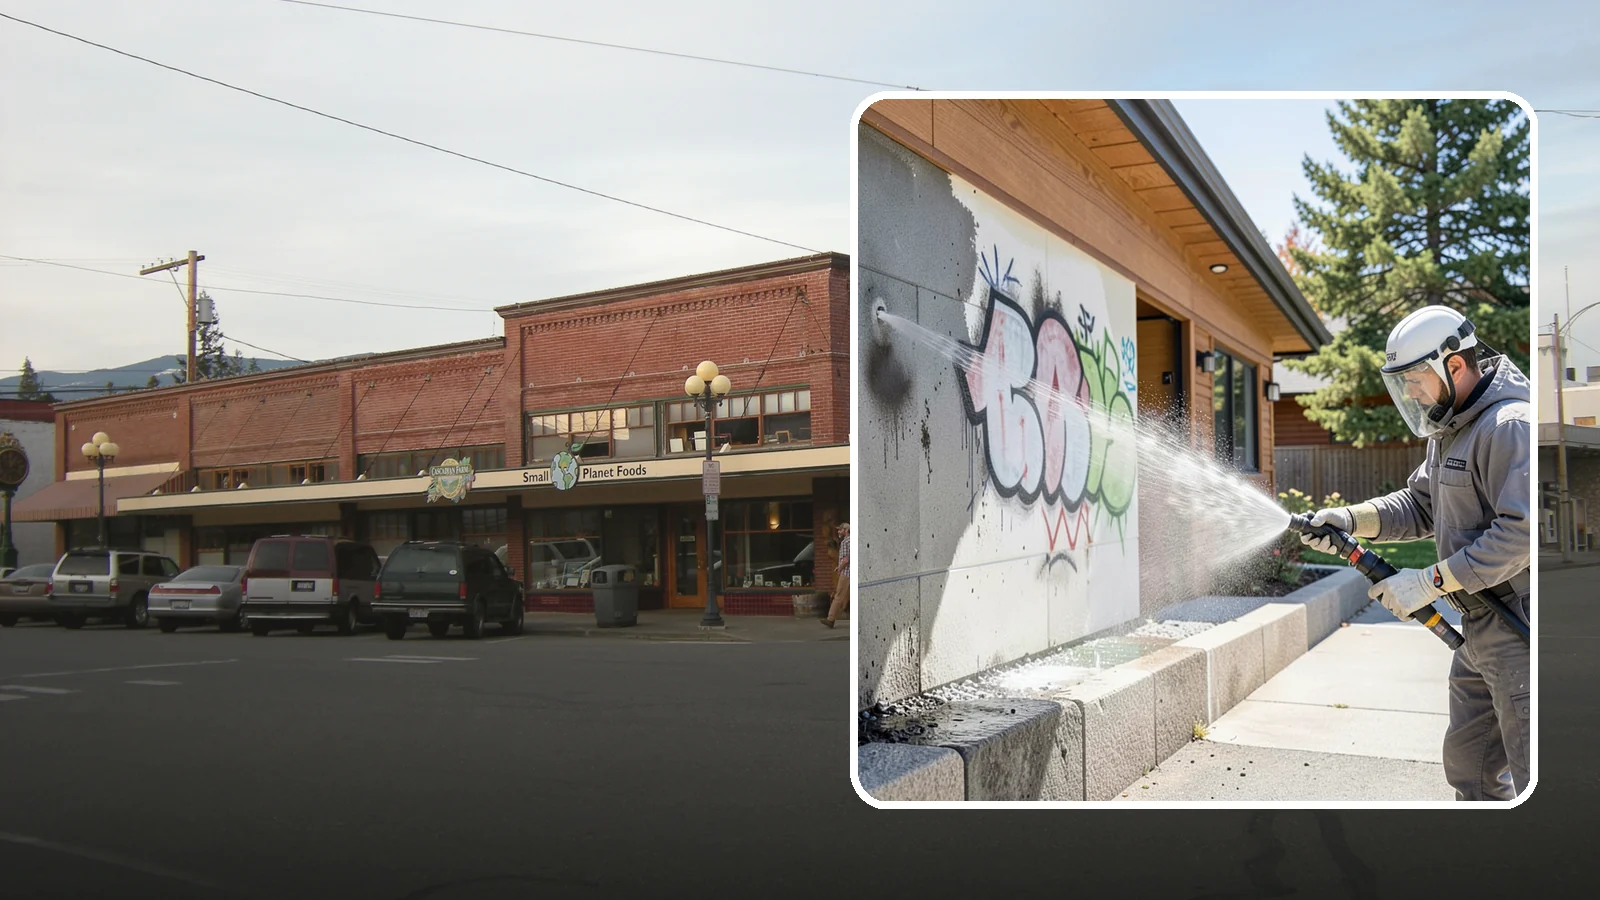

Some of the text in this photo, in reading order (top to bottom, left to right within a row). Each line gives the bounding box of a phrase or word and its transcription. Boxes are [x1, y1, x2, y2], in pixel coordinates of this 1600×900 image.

[523, 464, 647, 483] Small Planet Foods
